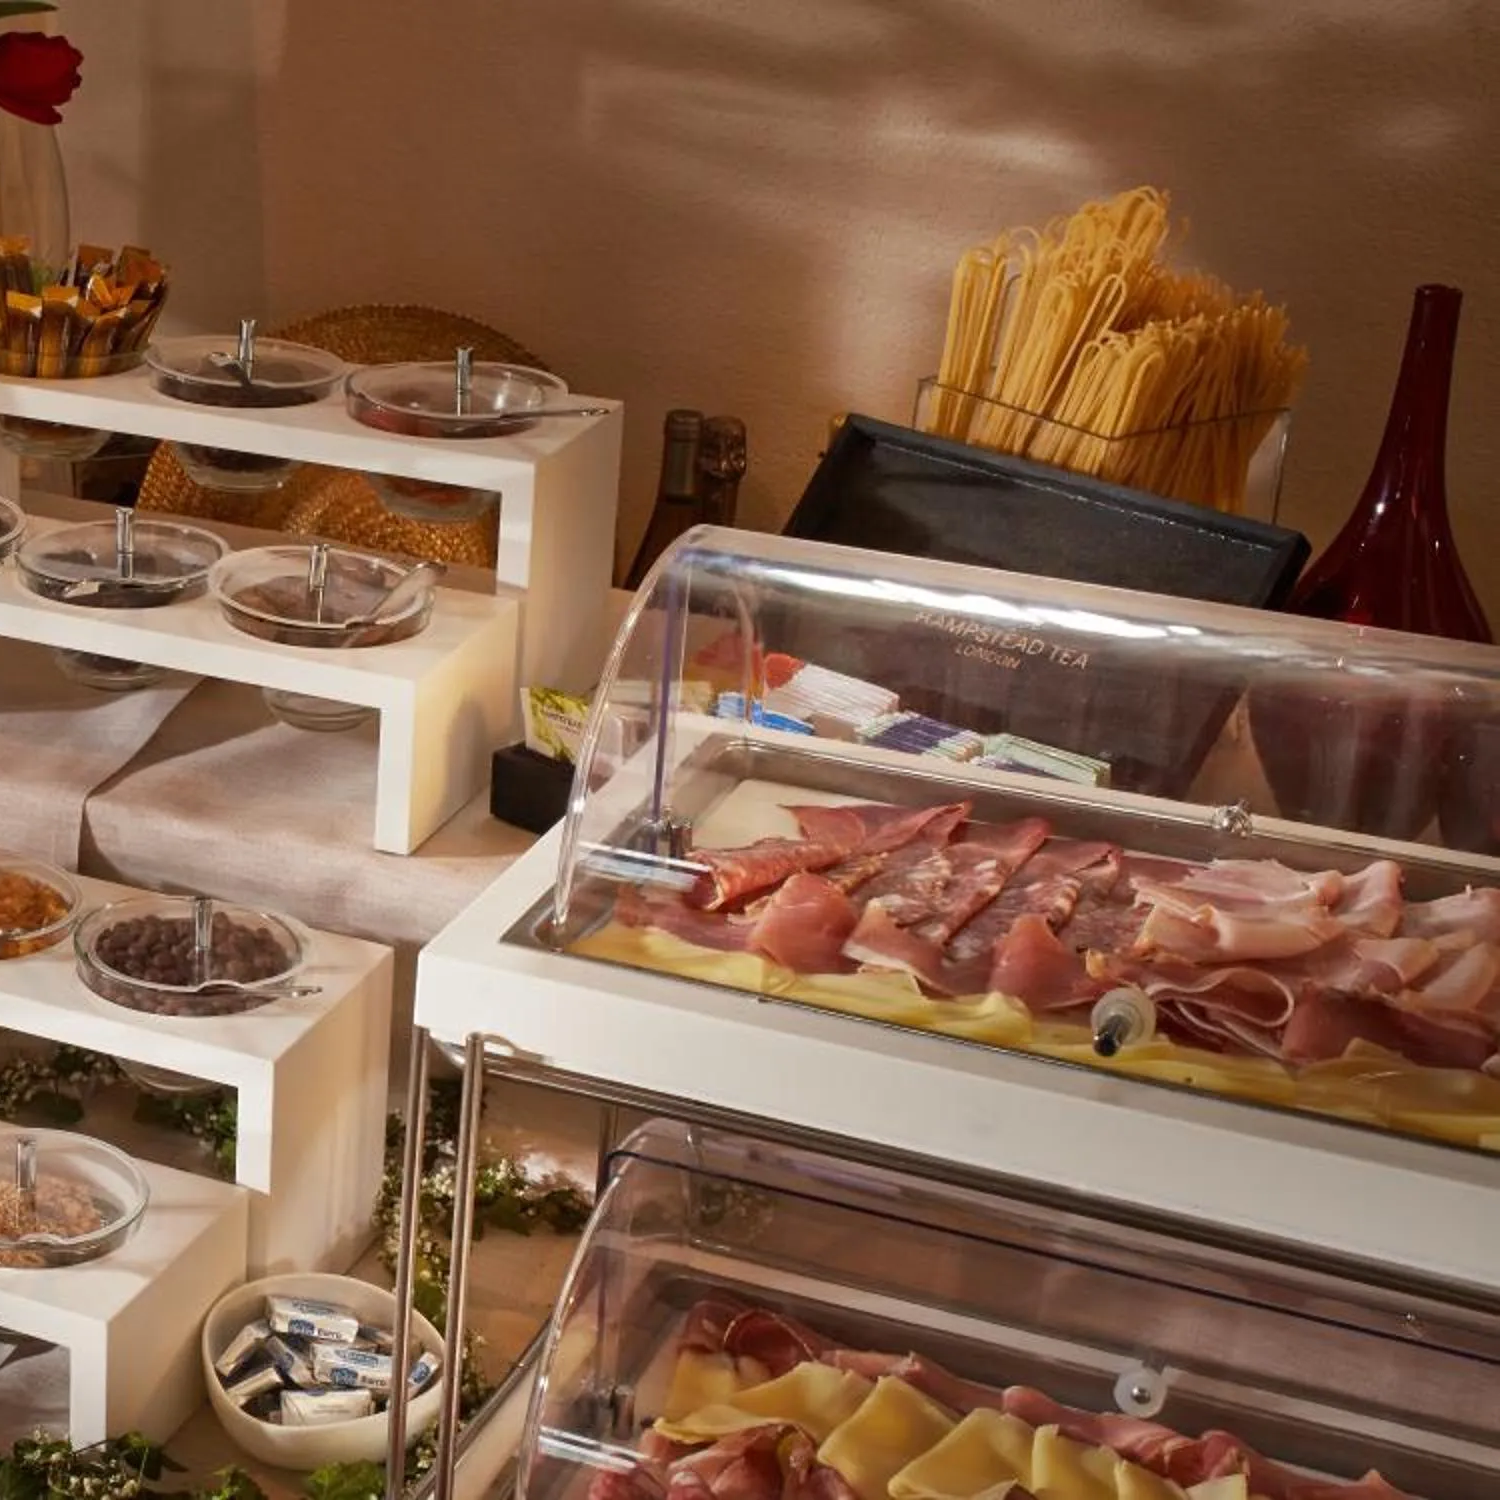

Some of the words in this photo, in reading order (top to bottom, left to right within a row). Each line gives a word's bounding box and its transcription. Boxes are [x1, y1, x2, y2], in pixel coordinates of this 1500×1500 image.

[914, 611, 1045, 655] HAMPSTEAD
[1049, 644, 1089, 669] TEA
[955, 643, 1022, 669] LONDON
